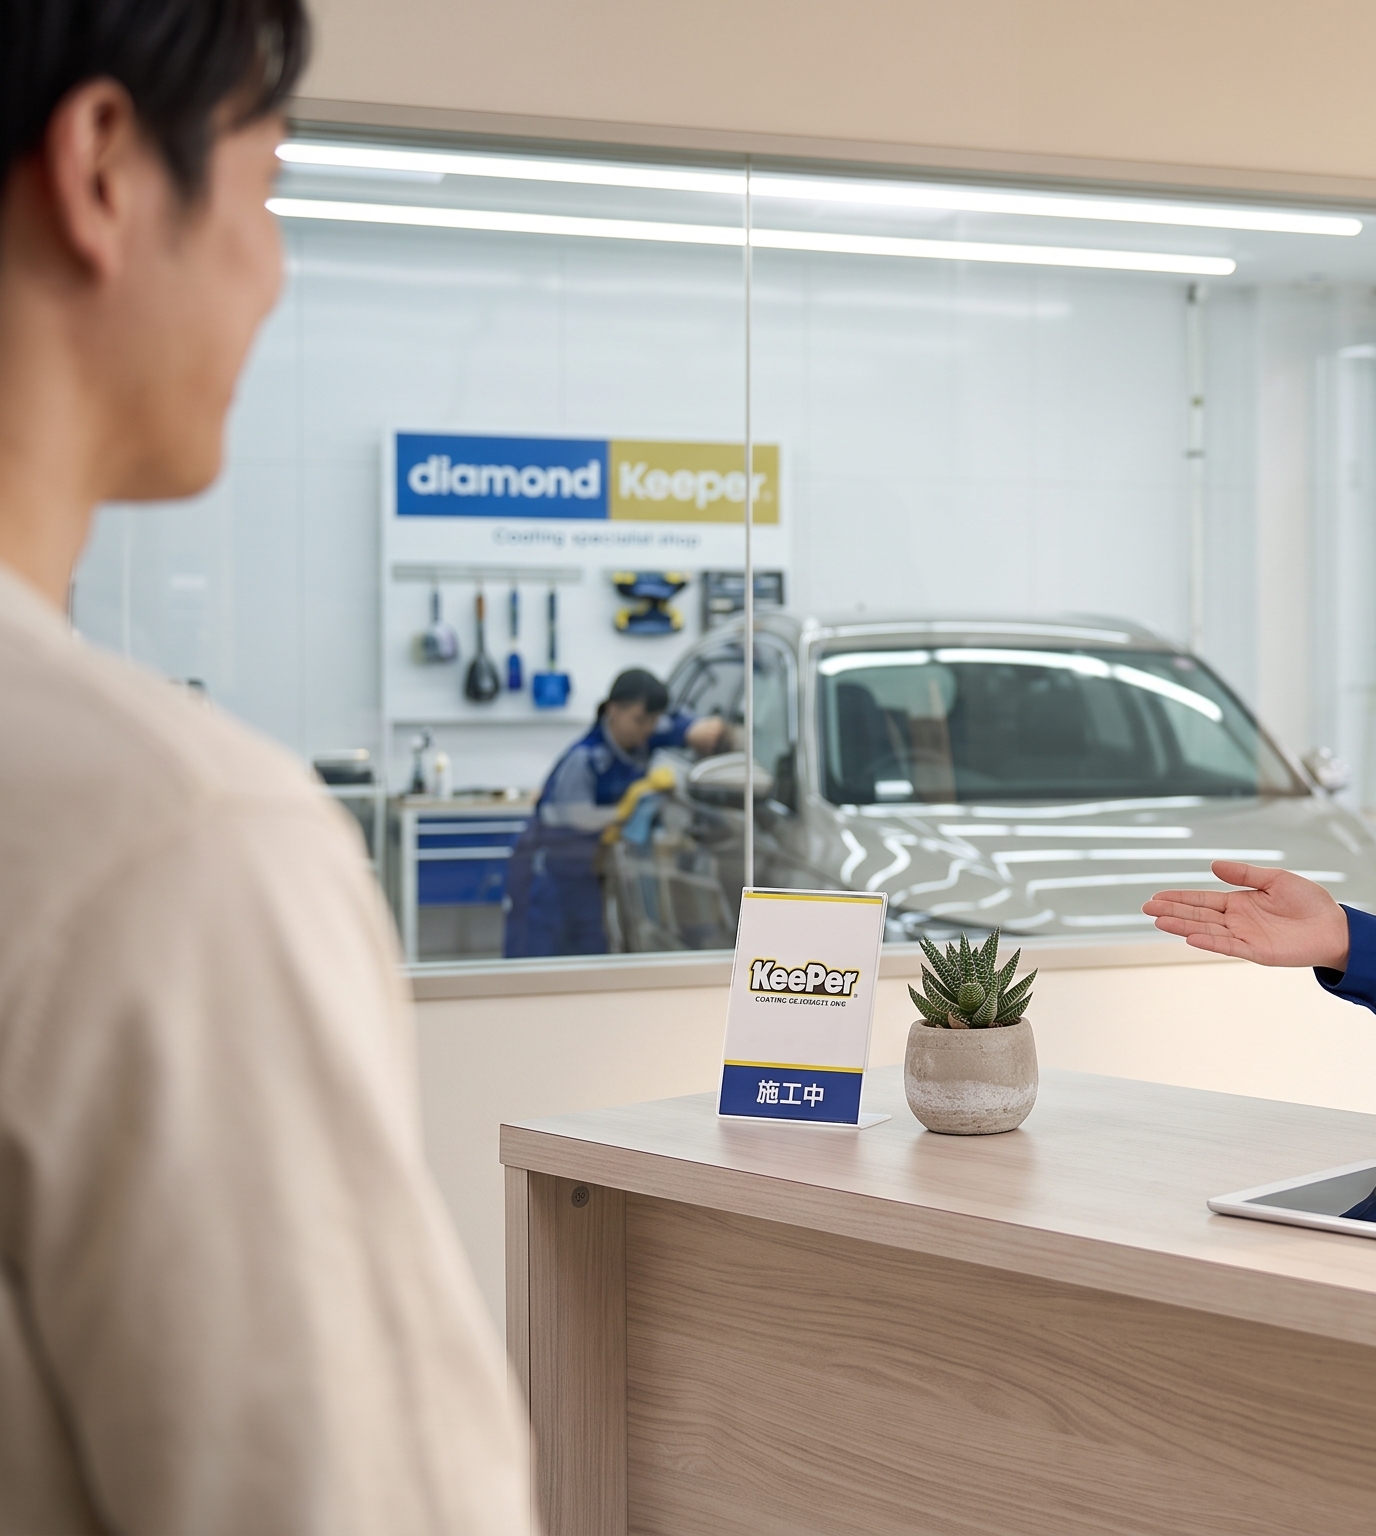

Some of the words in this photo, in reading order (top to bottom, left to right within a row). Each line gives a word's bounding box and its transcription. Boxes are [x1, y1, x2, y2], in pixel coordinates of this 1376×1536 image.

[407, 455, 601, 498] diamond
[618, 461, 767, 510] Keeper
[493, 527, 566, 548] Coating
[751, 960, 858, 996] KeePer
[756, 1079, 824, 1107] 施工中
